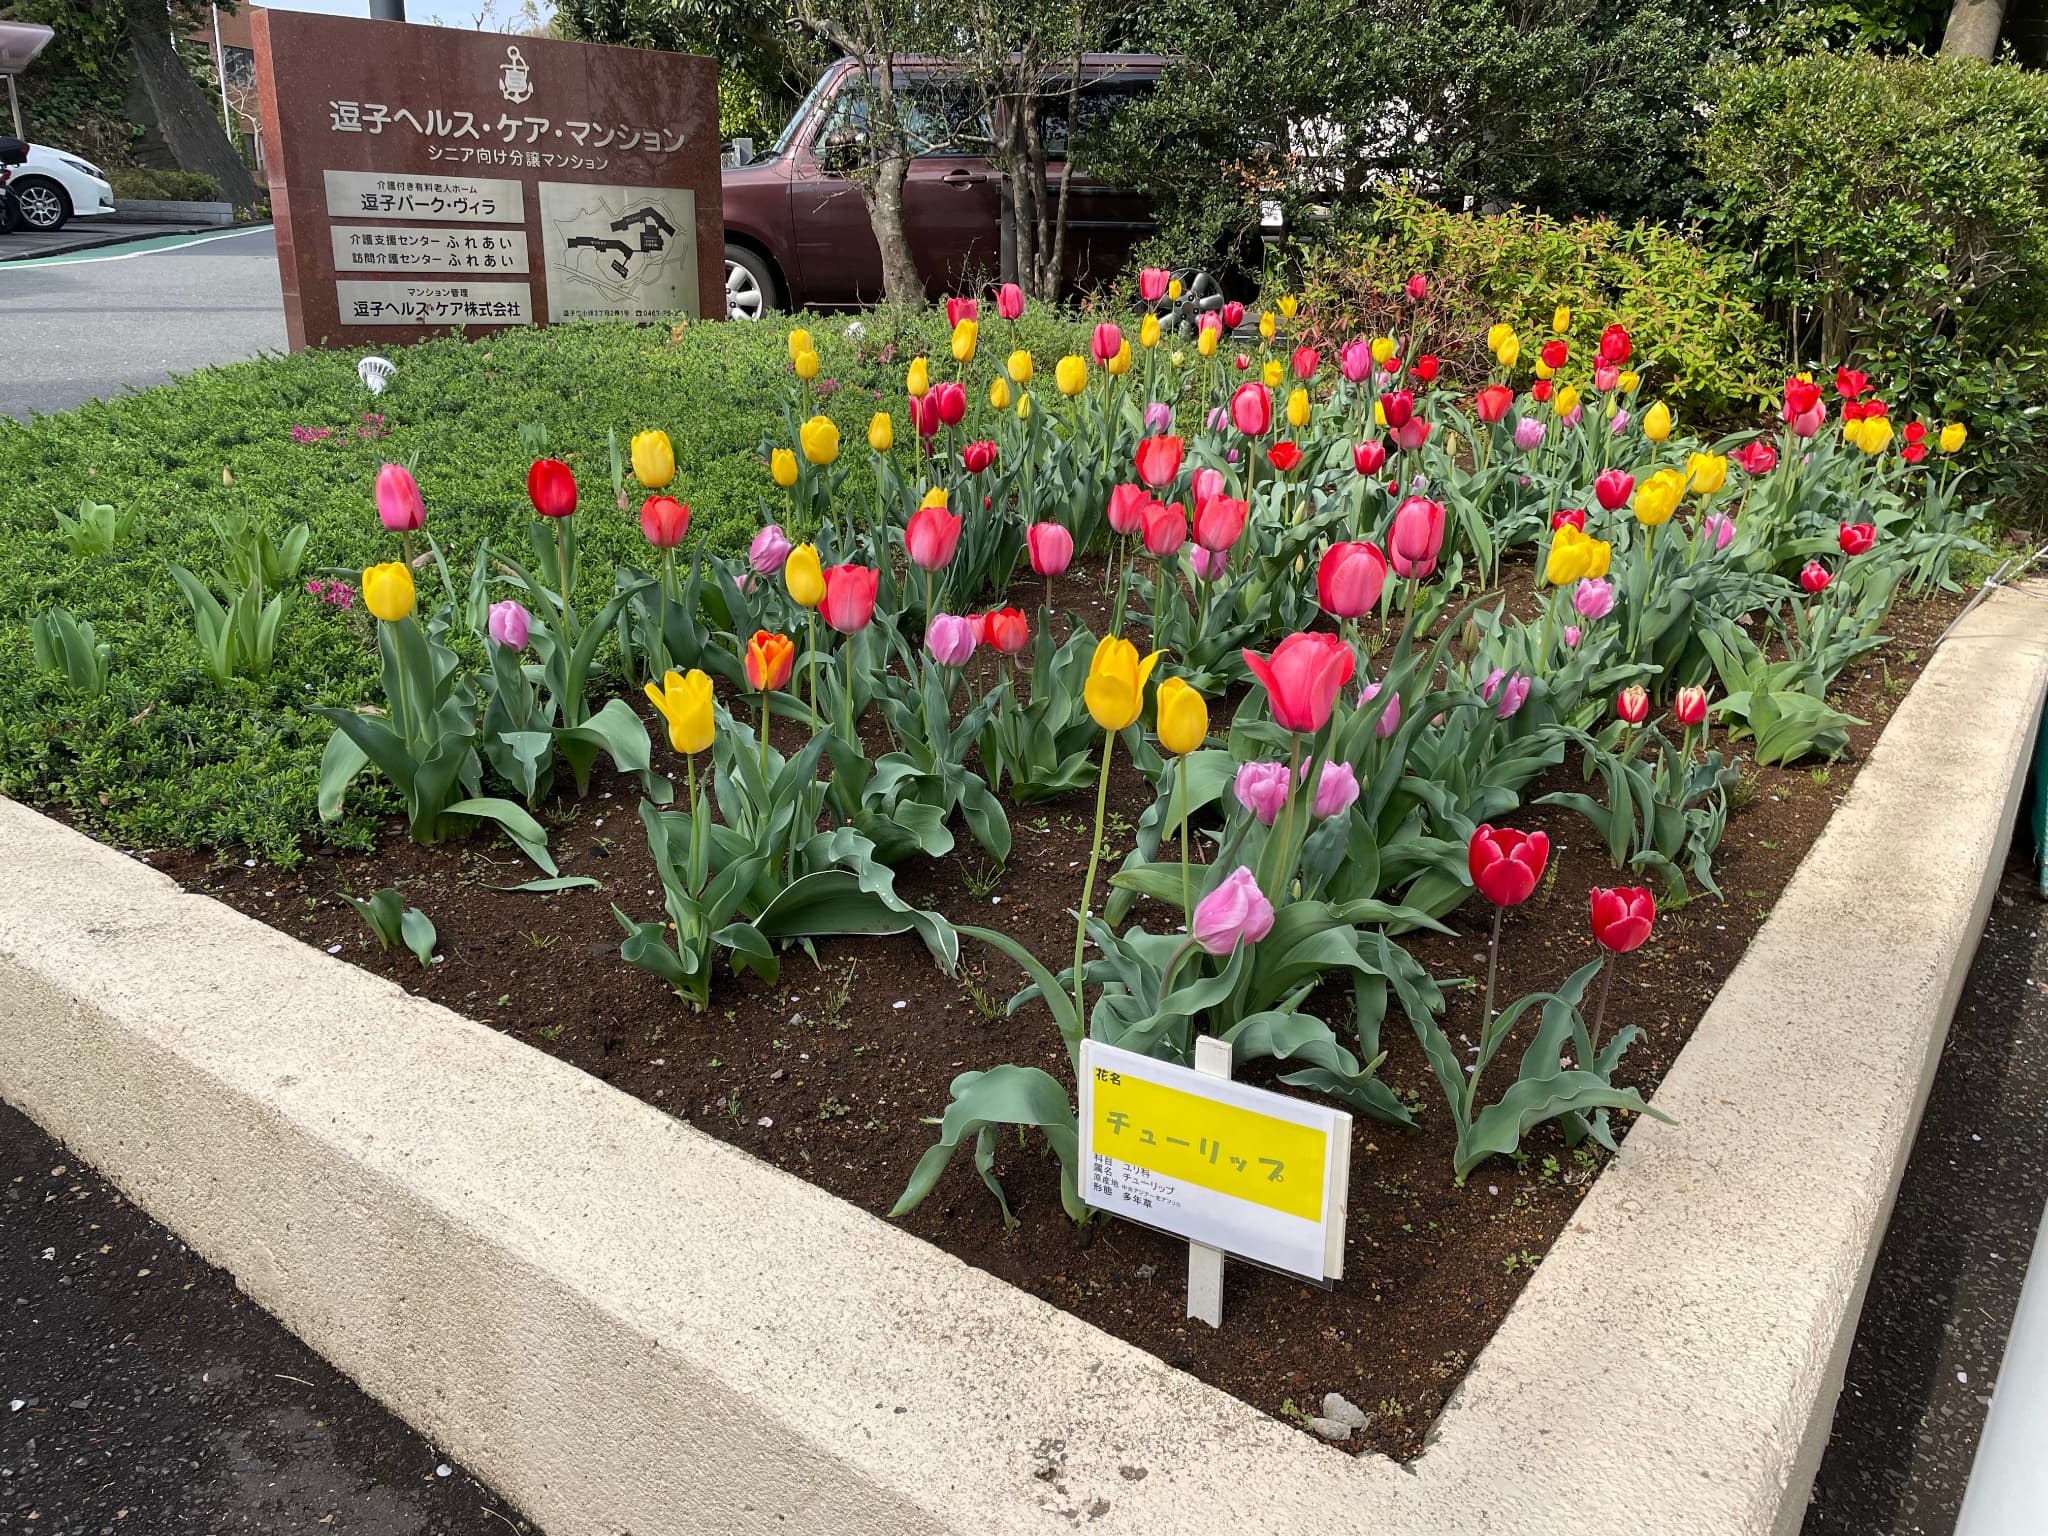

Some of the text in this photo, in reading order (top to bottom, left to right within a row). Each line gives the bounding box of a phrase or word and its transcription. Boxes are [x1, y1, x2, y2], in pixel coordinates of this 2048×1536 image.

[329, 100, 685, 153] 逗子ヘルス・ケア・マンション
[427, 145, 609, 171] シニア向け分譲マンション
[376, 180, 478, 195] 介護付き有料老人ホーム
[361, 193, 496, 216] 逗子パーク・ヴィラ
[350, 233, 512, 250] 介護支援センター ふれあい
[352, 252, 514, 268] 訪問介護センター ふれあい
[407, 287, 469, 298] マンション管理
[353, 301, 521, 318] 逗子ヘルス・ケア株式会社
[1095, 1067, 1121, 1087] 花名
[1106, 1111, 1285, 1183] チューリップ
[1094, 1152, 1151, 1179] 科目 ユリ科
[1093, 1162, 1176, 1195] 属名 チューリップ
[1093, 1182, 1154, 1209] 形態 多年草
